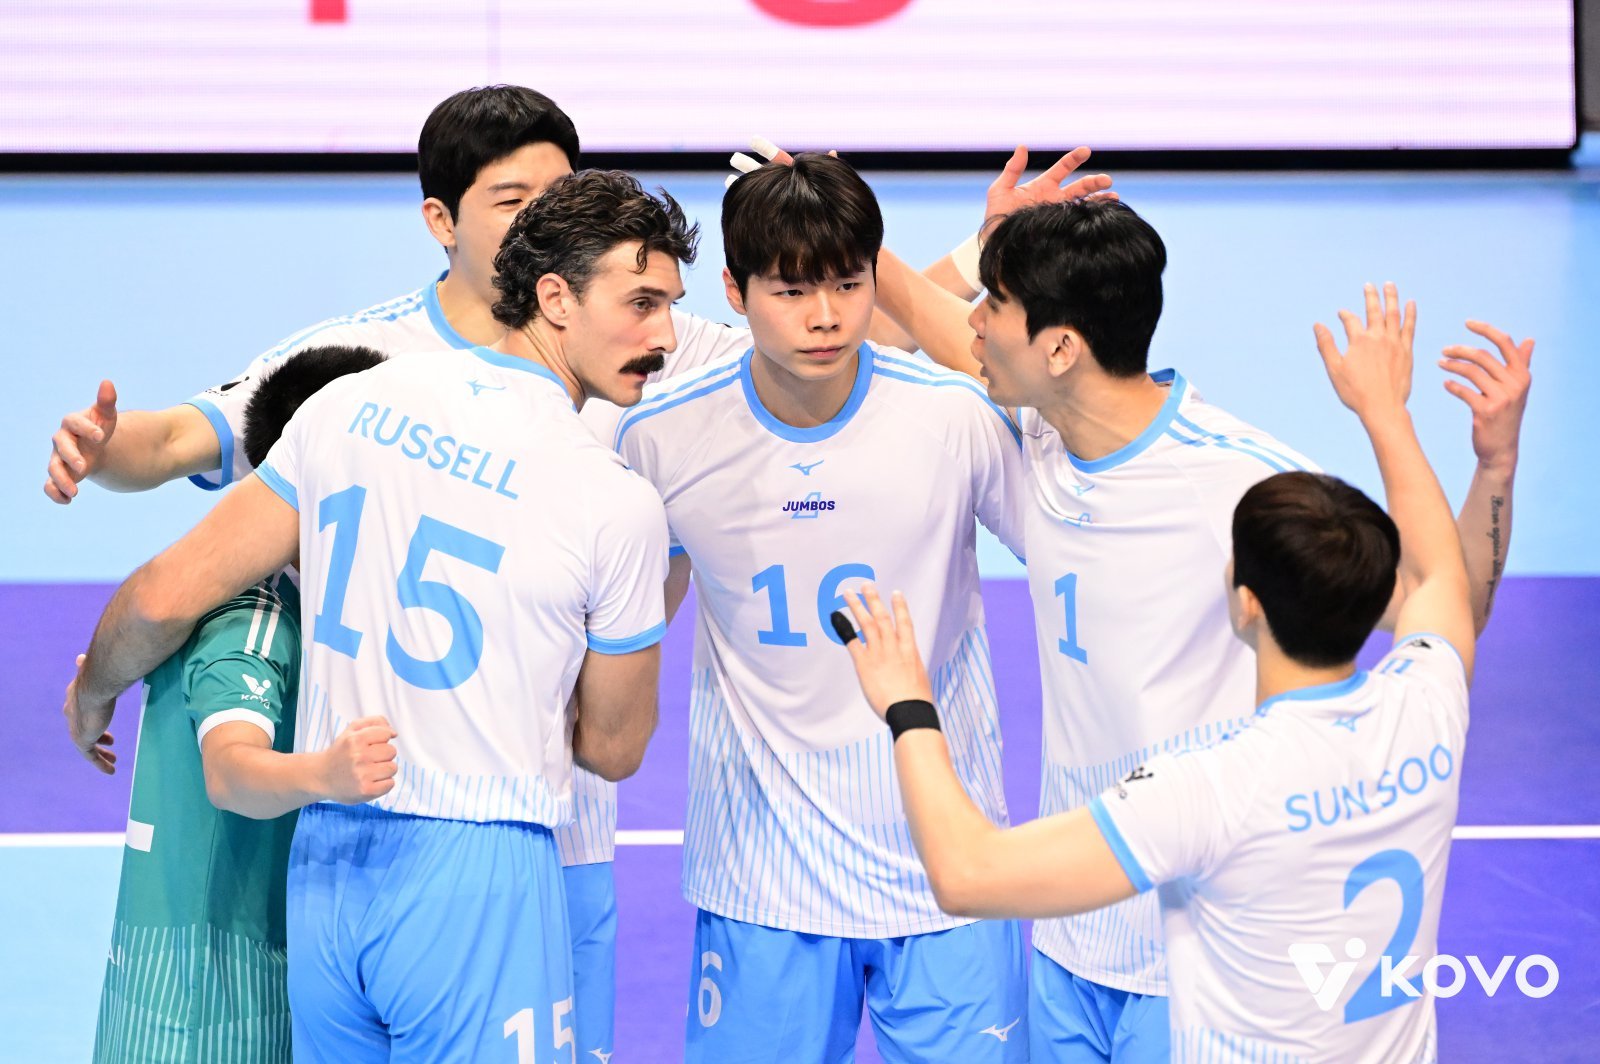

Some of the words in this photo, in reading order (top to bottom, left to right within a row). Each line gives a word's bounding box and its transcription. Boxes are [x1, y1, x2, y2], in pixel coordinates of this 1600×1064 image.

[349, 402, 519, 500] RUSSELL
[782, 500, 836, 512] JUMBOS
[313, 484, 505, 691] 15
[751, 562, 876, 648] 16
[1054, 573, 1089, 666] 1
[1343, 849, 1425, 1024] 2
